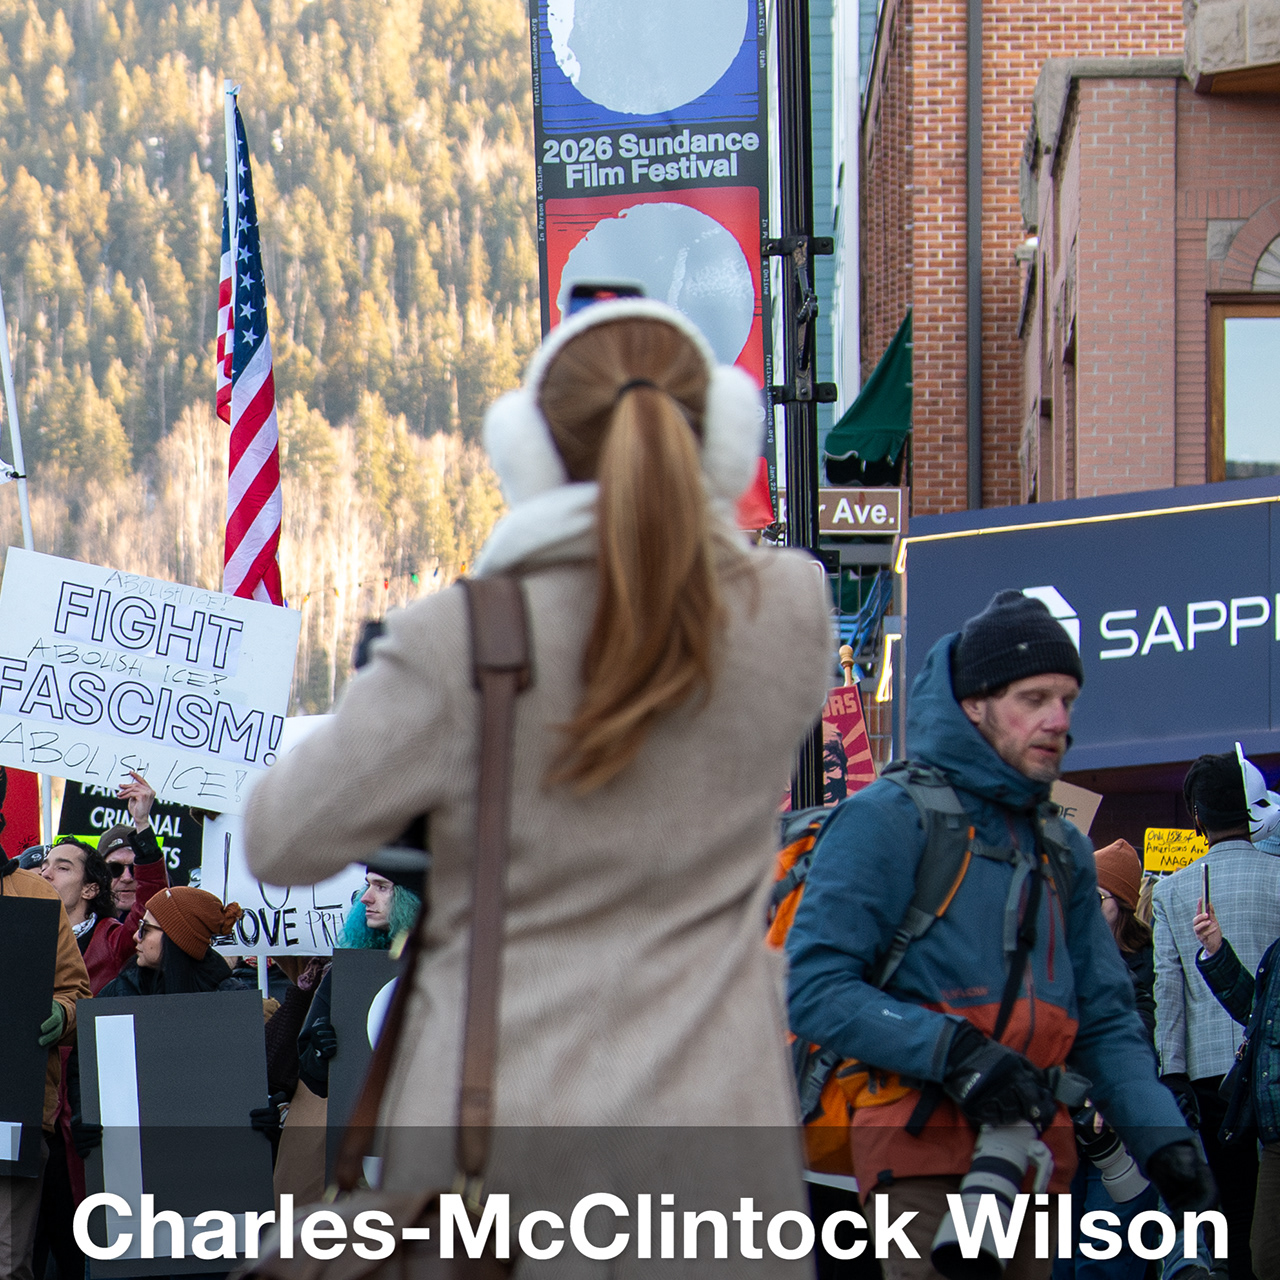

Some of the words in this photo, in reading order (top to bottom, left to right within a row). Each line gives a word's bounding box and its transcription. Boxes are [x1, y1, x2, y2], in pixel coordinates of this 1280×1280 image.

[542, 134, 613, 163] 2026
[618, 130, 760, 158] Sundance
[565, 161, 625, 188] Film
[632, 153, 738, 183] Festival
[832, 498, 895, 524] Ave.
[104, 570, 184, 604] ABOLISH
[187, 591, 233, 611] ICE!
[53, 581, 244, 670] FIGHT
[27, 637, 142, 677] ABOLISH
[158, 760, 248, 803] ICE!
[90, 806, 182, 838] CRIMNAL
[1160, 855, 1195, 867] MAGA
